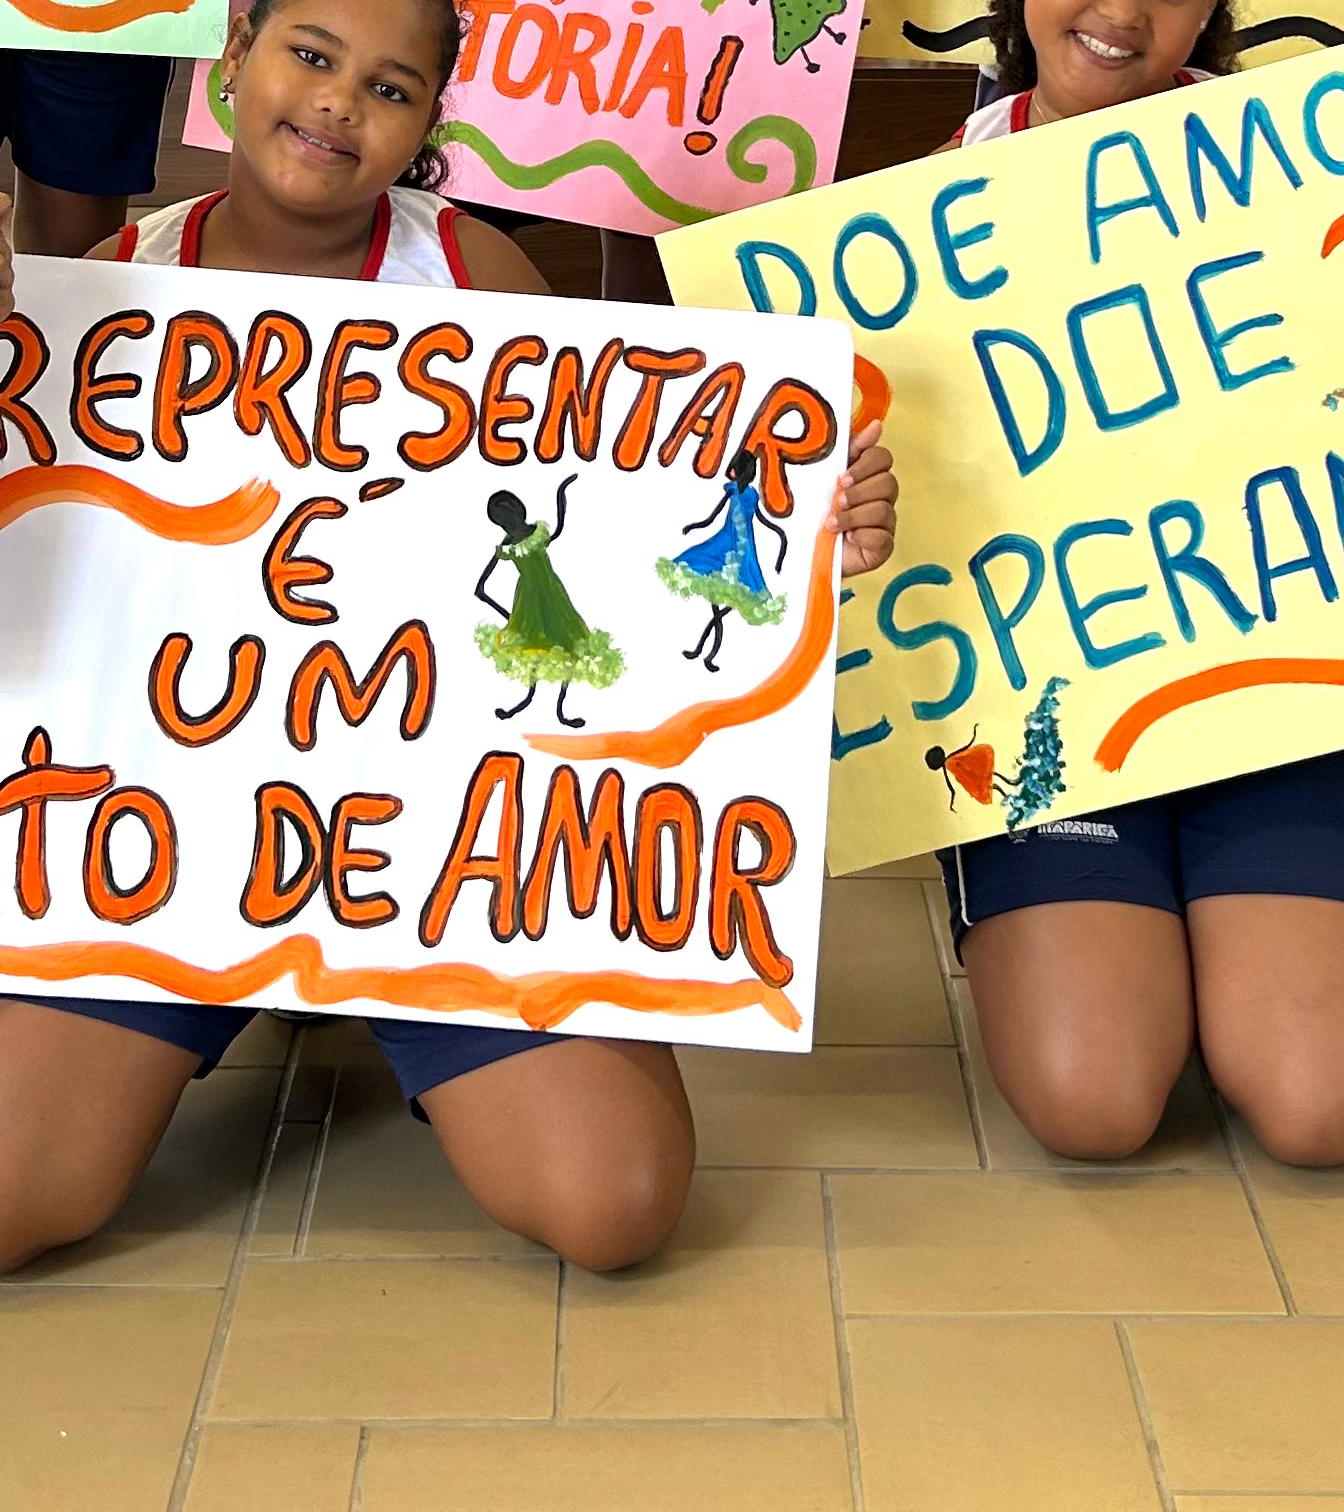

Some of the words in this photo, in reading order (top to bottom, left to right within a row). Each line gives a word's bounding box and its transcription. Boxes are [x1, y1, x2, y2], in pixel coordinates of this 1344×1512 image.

[735, 177, 1011, 331] DOE
[972, 251, 1297, 476] DOE
[262, 476, 407, 626] É
[148, 619, 437, 752] UM
[239, 779, 405, 929] DE
[418, 749, 796, 988] AMOR
